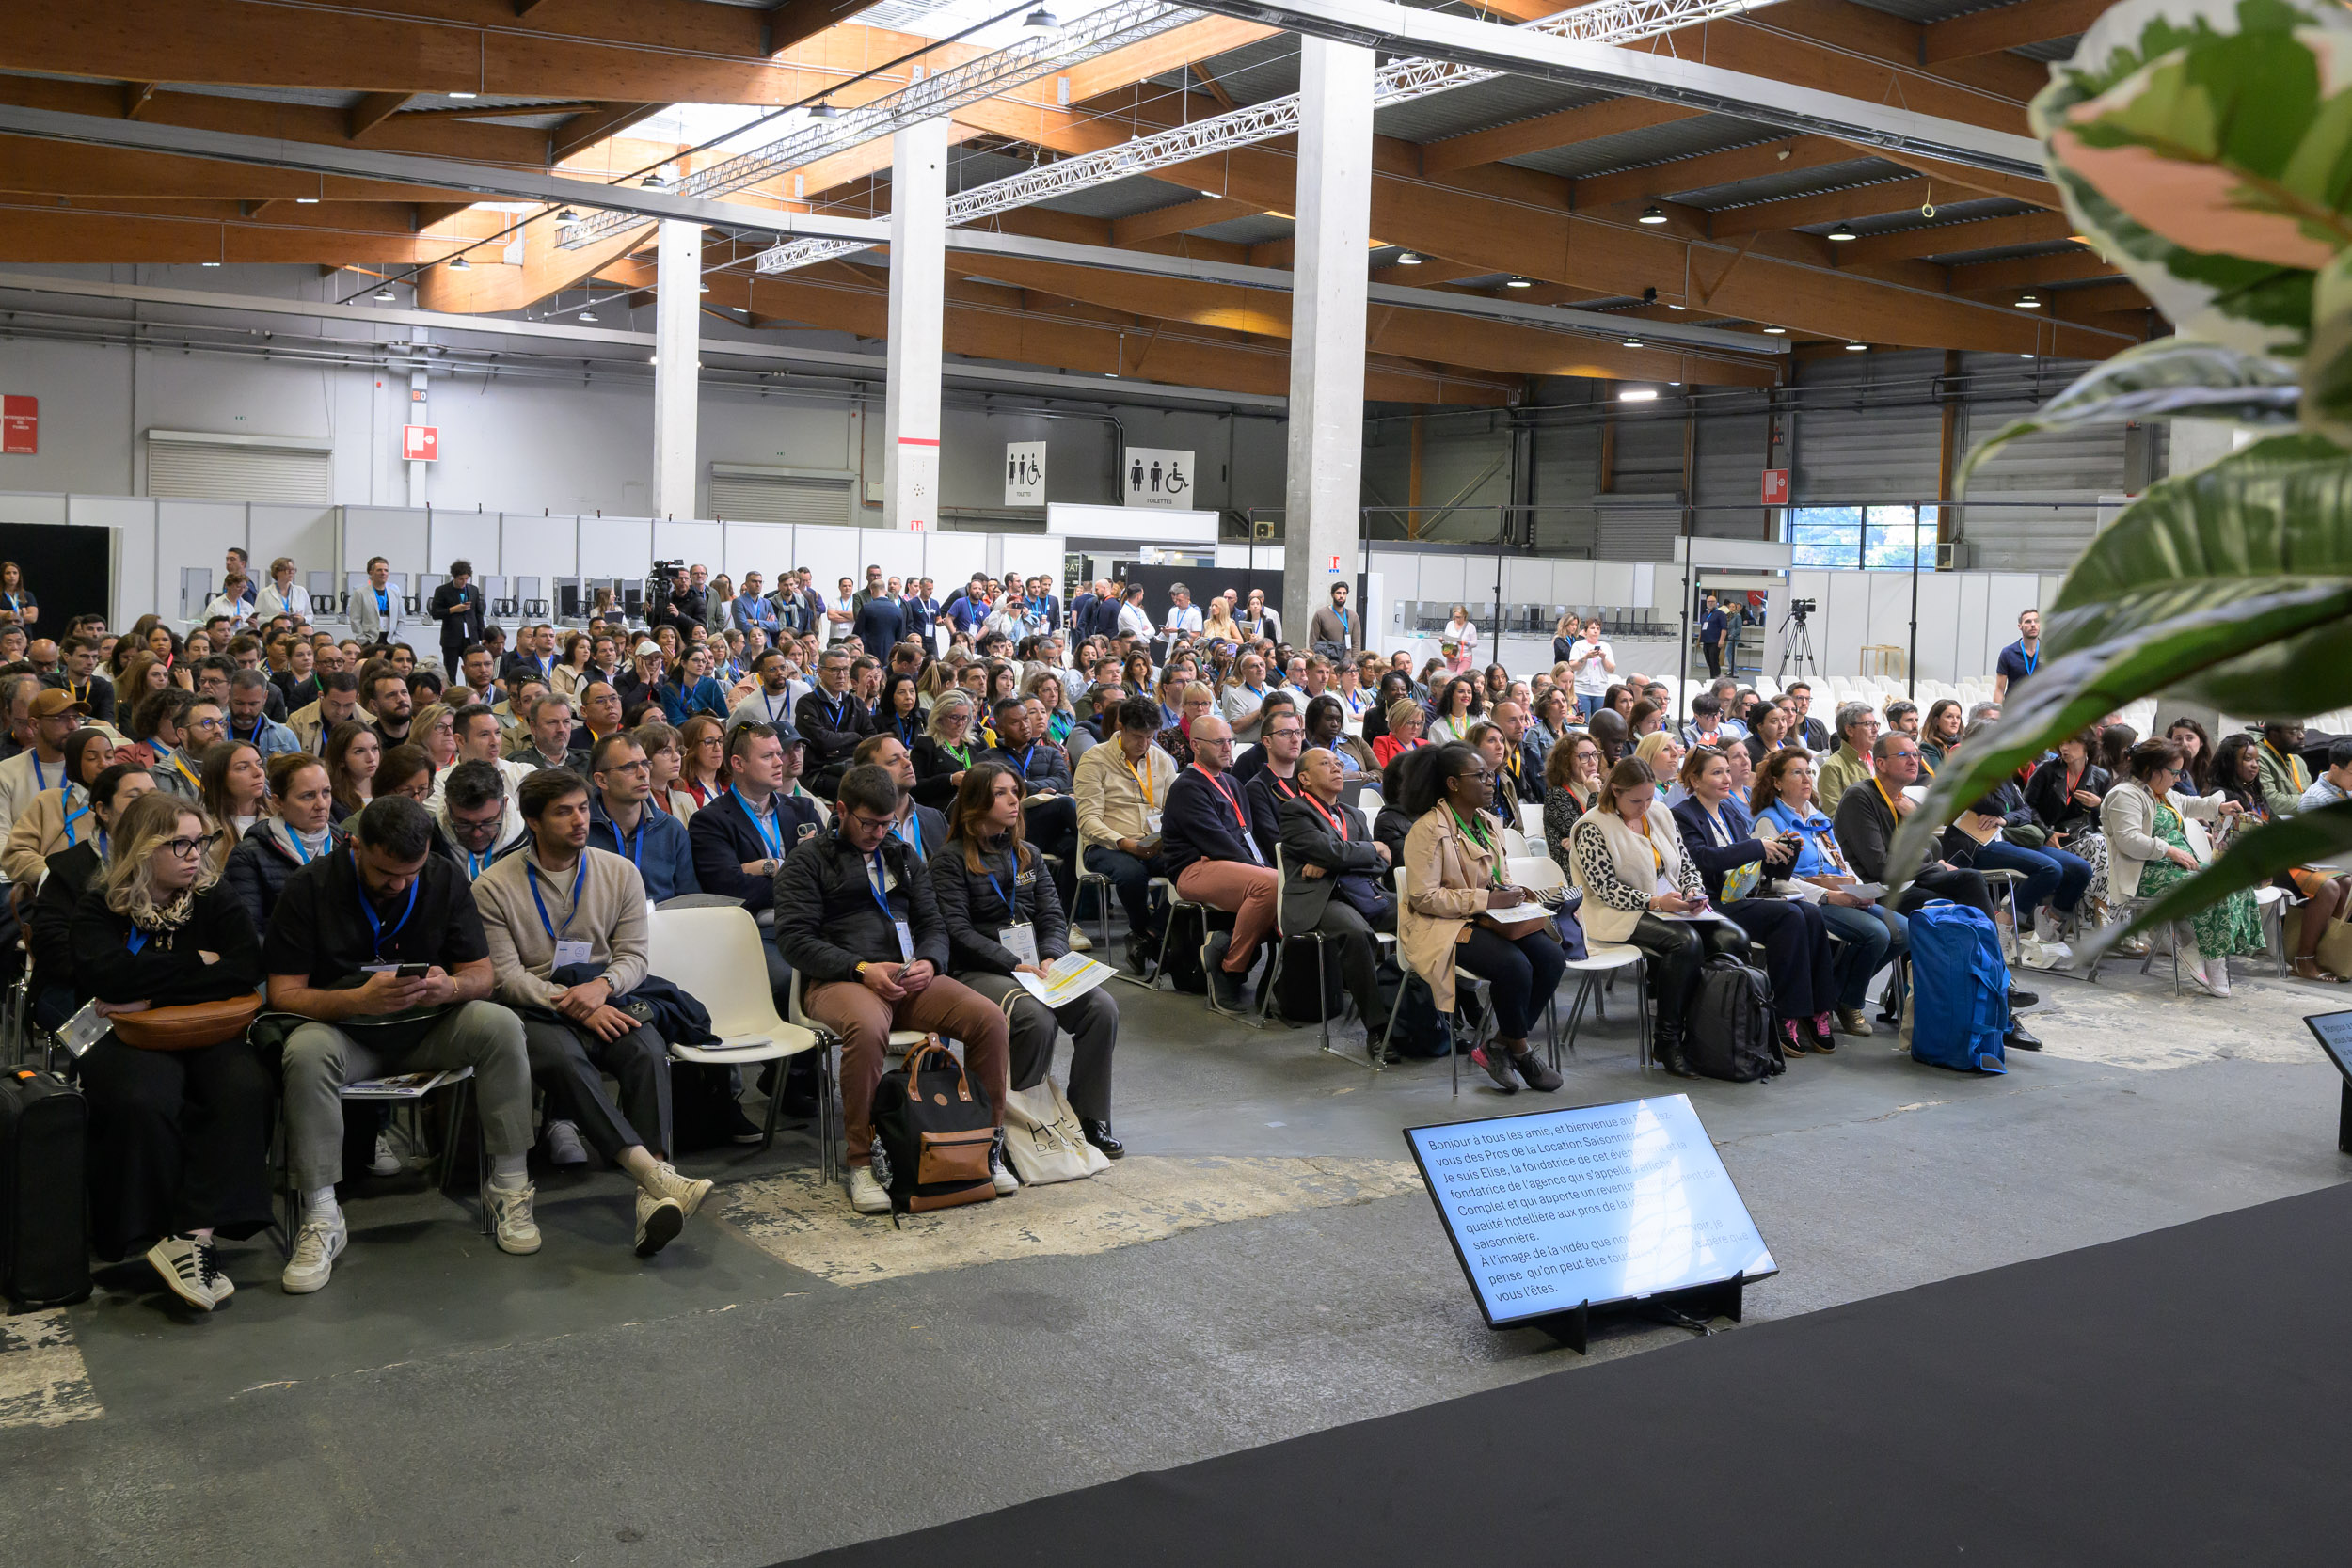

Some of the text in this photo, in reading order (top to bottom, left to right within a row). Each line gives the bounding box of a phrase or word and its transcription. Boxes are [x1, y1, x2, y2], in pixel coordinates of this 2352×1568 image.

[1428, 1138, 1470, 1150] Bonjour
[1472, 1134, 1481, 1146] à
[1481, 1133, 1506, 1144] tous
[1505, 1131, 1524, 1141] les
[1524, 1126, 1554, 1139] amis,
[1554, 1125, 1566, 1134] et
[1565, 1118, 1619, 1132] bienvenue
[1619, 1117, 1633, 1126] au
[1435, 1156, 1463, 1167] vous
[1464, 1152, 1485, 1164] des
[1484, 1149, 1510, 1161] Pros
[1511, 1147, 1525, 1157] de
[1524, 1145, 1537, 1155] la
[1536, 1139, 1583, 1153] Location
[1443, 1173, 1455, 1183] Je
[1456, 1169, 1480, 1181] suis
[1479, 1166, 1511, 1179] Elise,
[1510, 1164, 1522, 1174] la
[1522, 1157, 1577, 1172] fondatrice
[1577, 1154, 1591, 1164] de
[1592, 1152, 1610, 1163] cet
[1664, 1141, 1677, 1151] et
[1676, 1139, 1688, 1149] la
[1450, 1184, 1506, 1200] fondatrice
[1507, 1181, 1522, 1192] de
[1568, 1171, 1585, 1184] qui
[1457, 1200, 1507, 1216] Complet
[1507, 1199, 1519, 1210] et
[1519, 1195, 1538, 1209] qui
[1538, 1191, 1581, 1206] apporte
[1581, 1188, 1596, 1198] un
[1595, 1181, 1636, 1195] revenue
[1701, 1168, 1717, 1179] de
[1466, 1217, 1504, 1235] qualité
[1503, 1212, 1556, 1227] hotellière
[1557, 1209, 1578, 1219] aux
[1577, 1205, 1601, 1218] pros
[1602, 1201, 1616, 1212] de
[1615, 1199, 1628, 1210] la
[1472, 1232, 1540, 1250] saisonnière.
[1479, 1254, 1490, 1268] À
[1533, 1247, 1548, 1259] de
[1547, 1245, 1560, 1256] la
[1559, 1240, 1589, 1254] vidéo
[1590, 1238, 1612, 1251] que
[1612, 1233, 1637, 1245] nou
[1691, 1219, 1711, 1232] voir,
[1488, 1271, 1523, 1287] pense
[1559, 1259, 1585, 1275] peut
[1584, 1257, 1607, 1268] être
[1606, 1251, 1632, 1263] tous
[1728, 1232, 1751, 1244] que
[1495, 1290, 1523, 1302] vous
